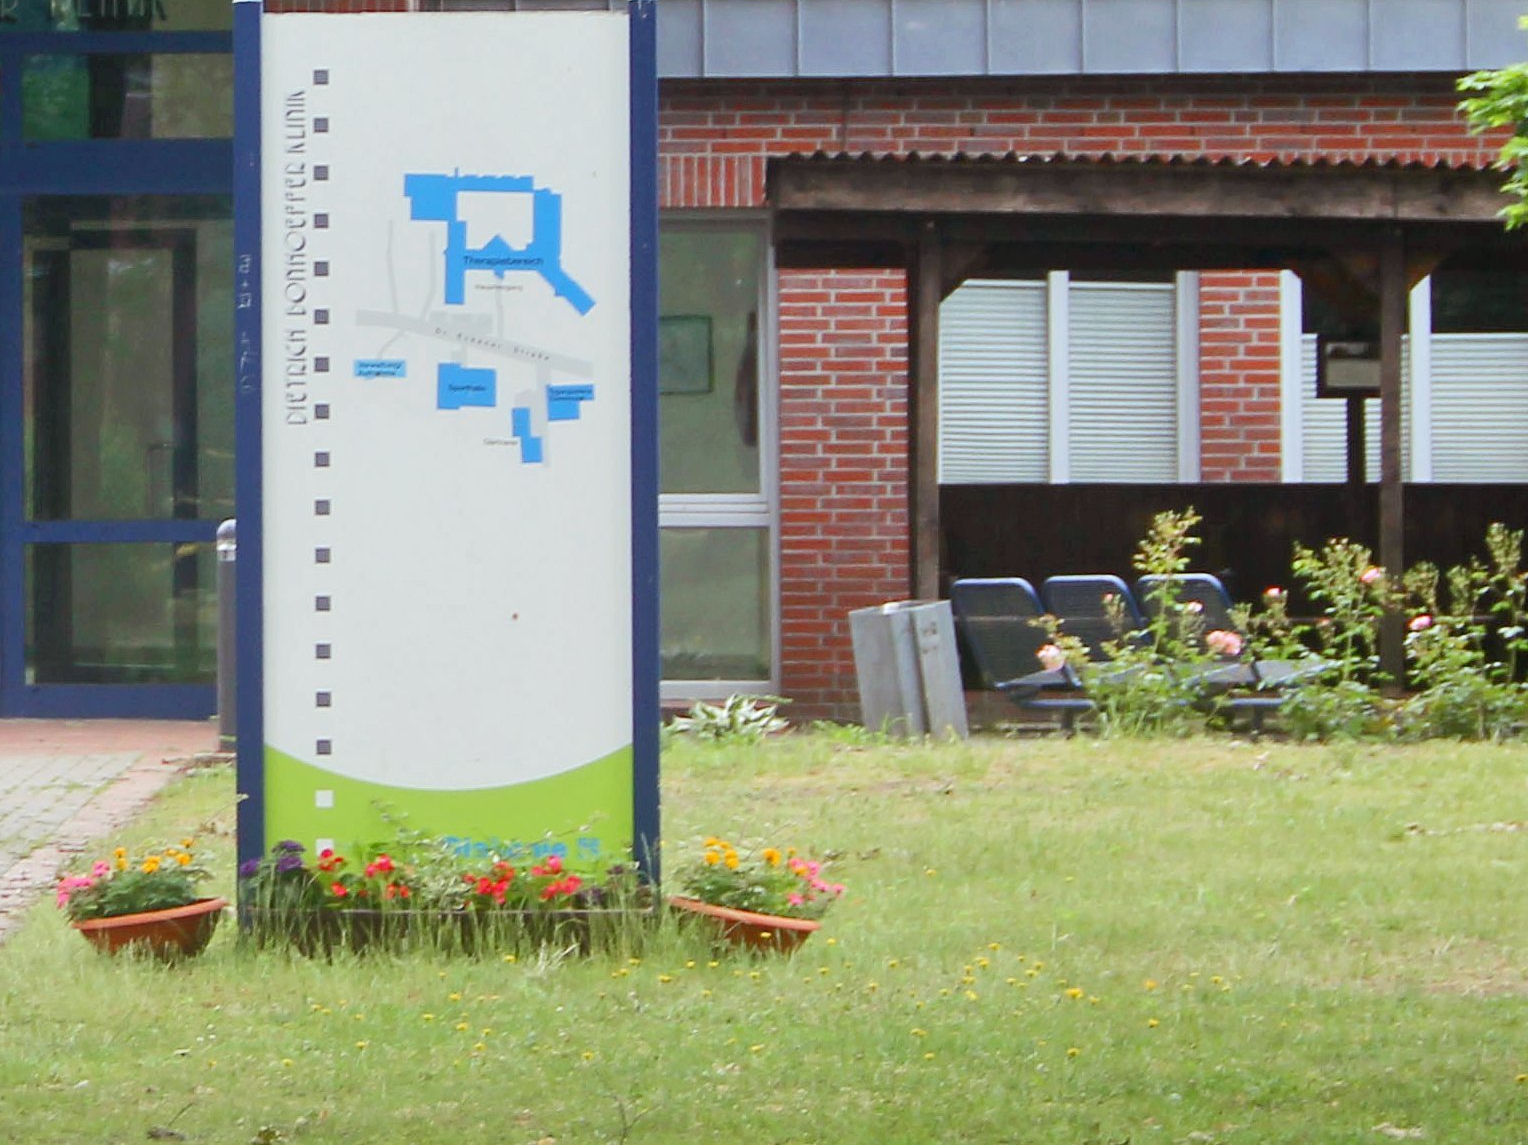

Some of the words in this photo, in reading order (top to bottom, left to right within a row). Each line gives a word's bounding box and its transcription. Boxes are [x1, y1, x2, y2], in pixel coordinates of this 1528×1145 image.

[284, 90, 307, 153] KLINIK
[284, 162, 307, 315] BONHOEFFER
[284, 330, 307, 425] DIETRICH
